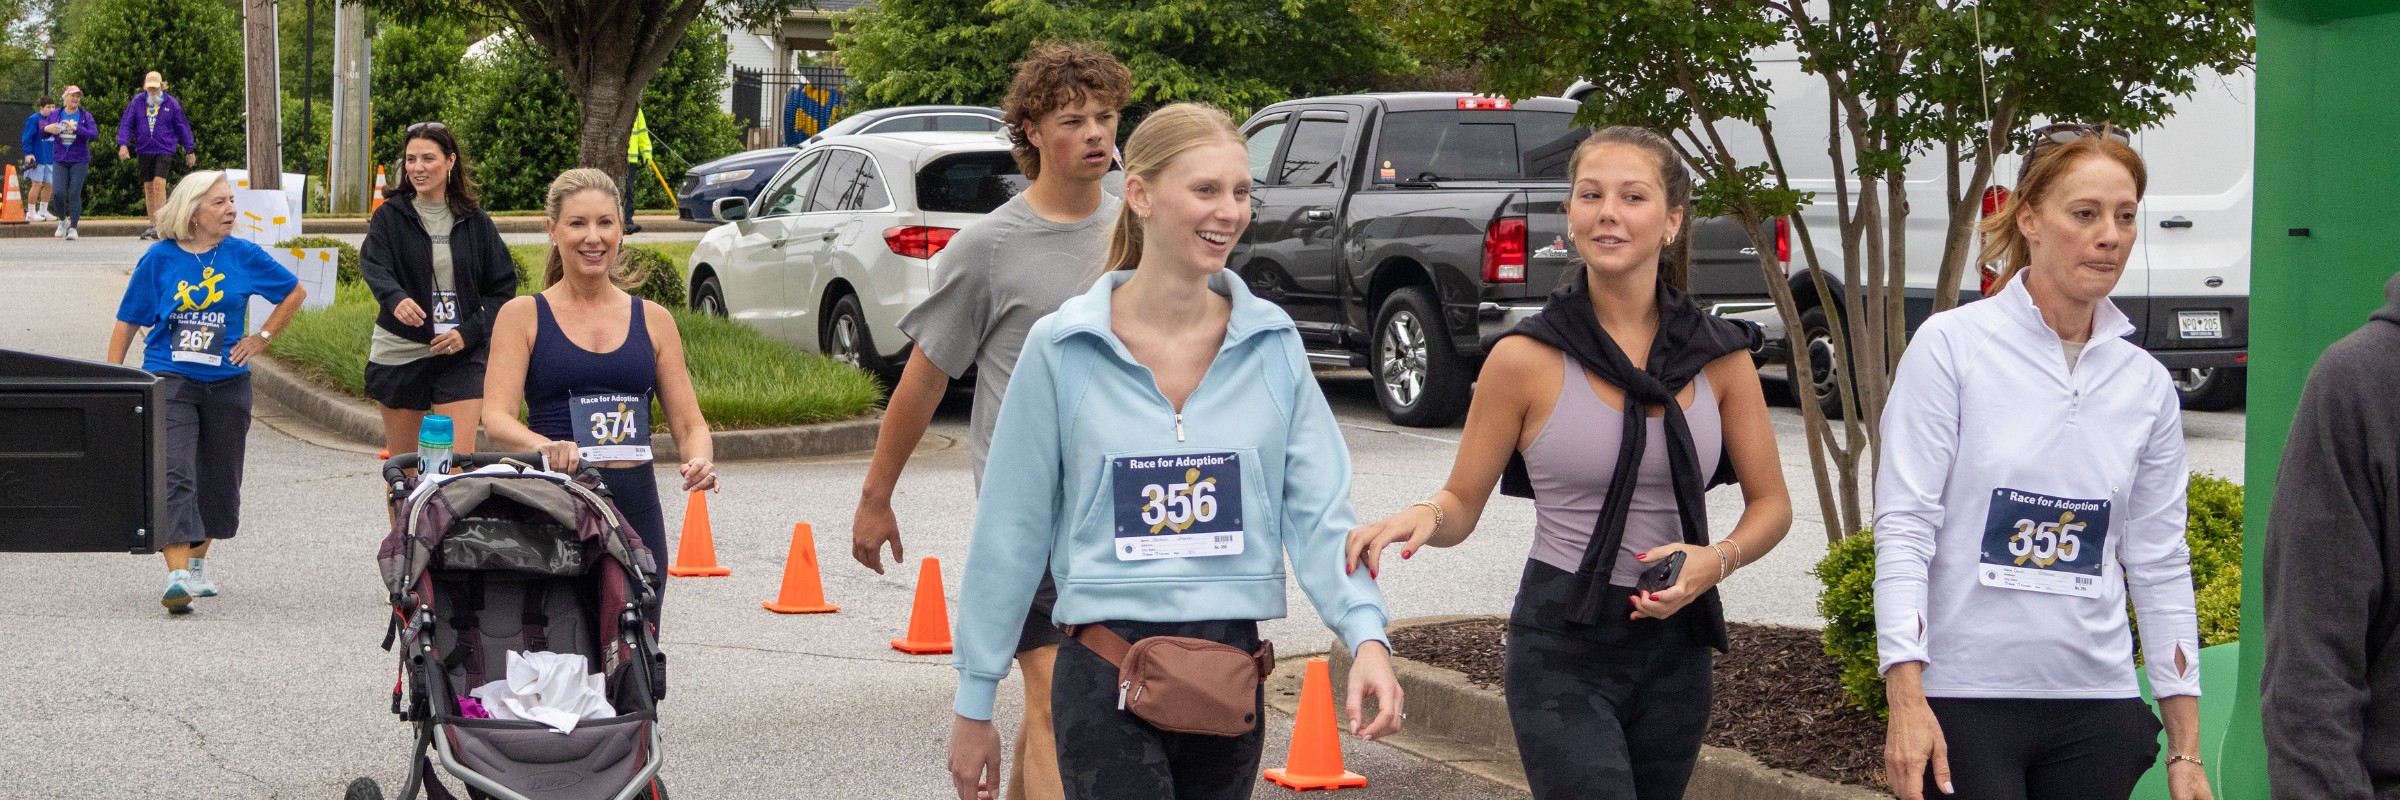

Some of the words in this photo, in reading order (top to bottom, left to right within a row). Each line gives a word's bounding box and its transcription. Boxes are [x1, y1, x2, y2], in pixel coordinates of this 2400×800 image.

[169, 312, 199, 320] RACE
[202, 312, 226, 323] FOR
[434, 301, 456, 320] 43
[2203, 318, 2219, 330] 205
[179, 329, 215, 350] 267
[611, 394, 639, 403] Adoption
[590, 411, 637, 439] 374
[1130, 459, 1156, 469] Race
[1157, 457, 1174, 468] for
[1175, 455, 1224, 468] Adoption
[1141, 481, 1218, 526] 356
[2009, 491, 2036, 505] Race
[2038, 496, 2054, 507] for
[2054, 498, 2099, 512] Adoption
[2008, 518, 2085, 562] 355
